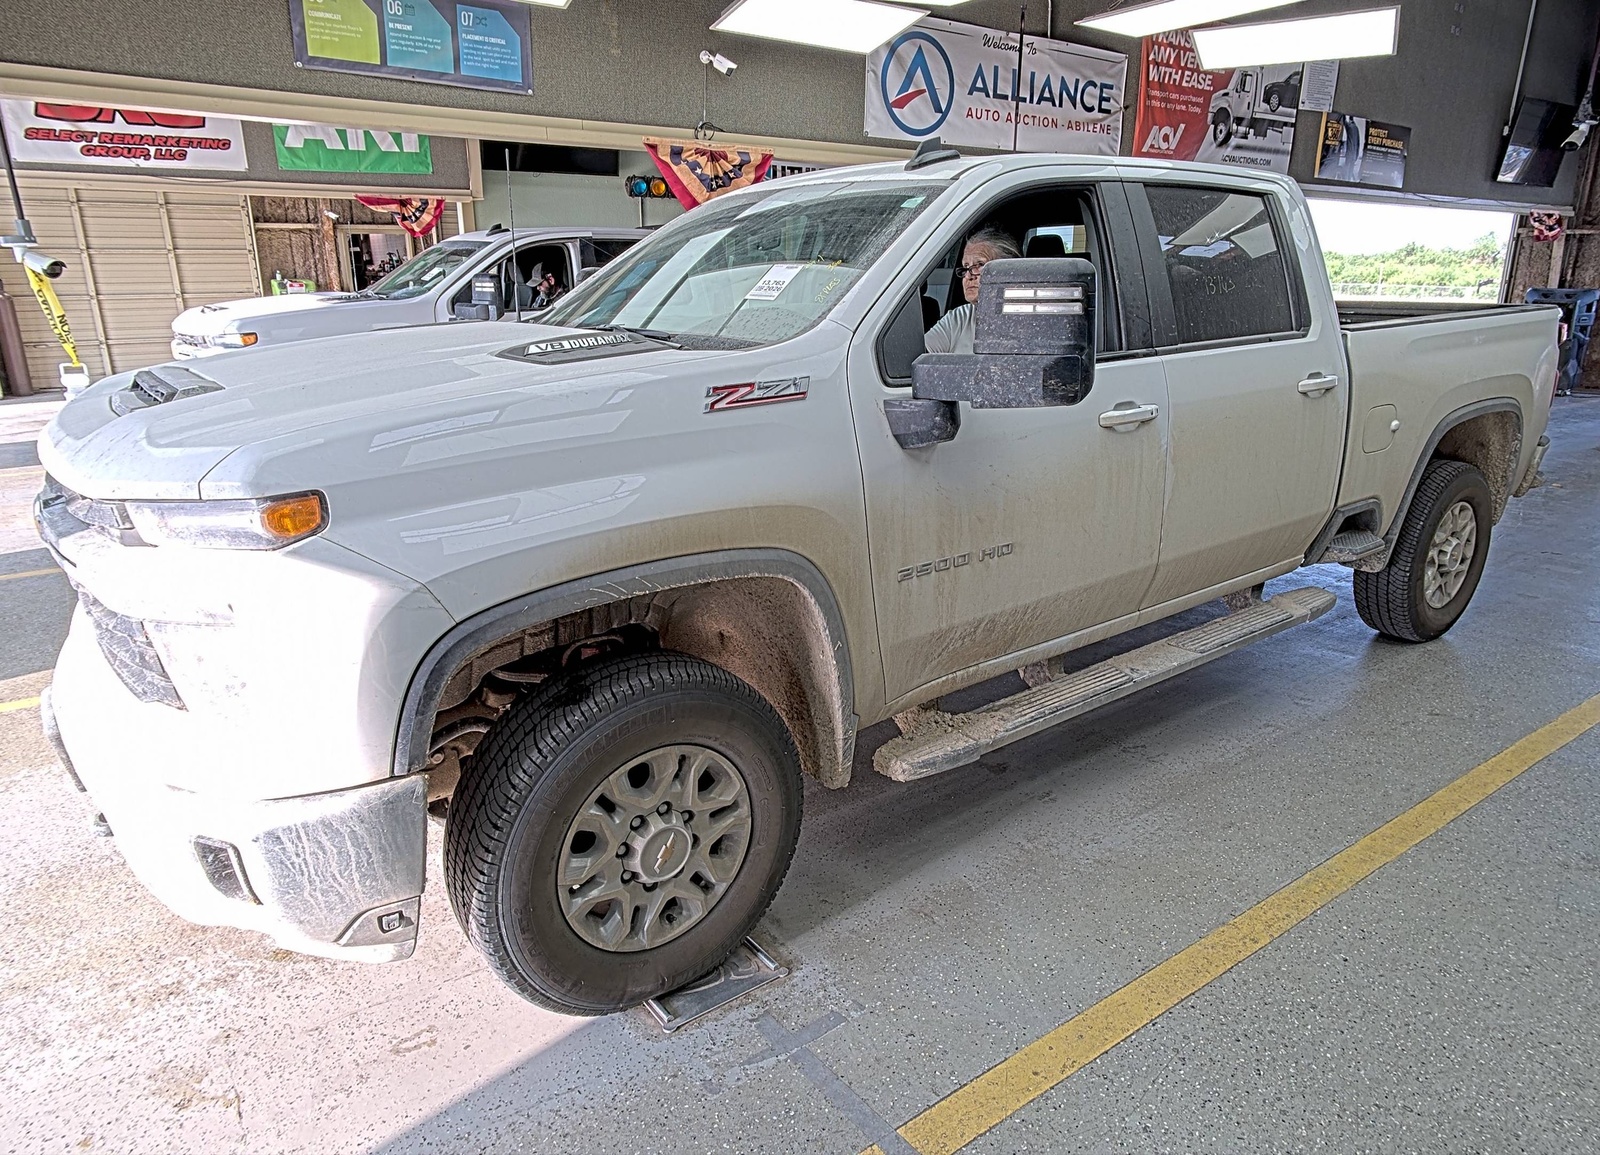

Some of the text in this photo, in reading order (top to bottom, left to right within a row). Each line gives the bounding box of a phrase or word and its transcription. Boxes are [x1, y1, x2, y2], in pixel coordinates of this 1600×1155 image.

[386, 0, 402, 16] 06
[461, 10, 473, 26] 07
[1026, 42, 1037, 55] To
[1148, 45, 1178, 65] ANY
[1148, 64, 1213, 90] WITH EASE.
[967, 63, 1114, 114] ALLIANCE
[1147, 88, 1168, 98] Transport
[1180, 94, 1203, 103] purchased
[1188, 104, 1202, 114] Today.
[966, 107, 1000, 122] AUTO
[1006, 114, 1058, 129] AUCTION
[1067, 120, 1111, 135] ABILENE
[25, 128, 231, 150] SELECT REMARKETING
[1141, 124, 1186, 152] ACV
[1368, 127, 1388, 137] PROTECT
[1368, 136, 1382, 146] EVERY
[80, 145, 187, 160] GROUP, LLC
[568, 334, 632, 349] DURAMAX
[701, 376, 812, 414] Z71
[897, 542, 1013, 582] 2500 HD
